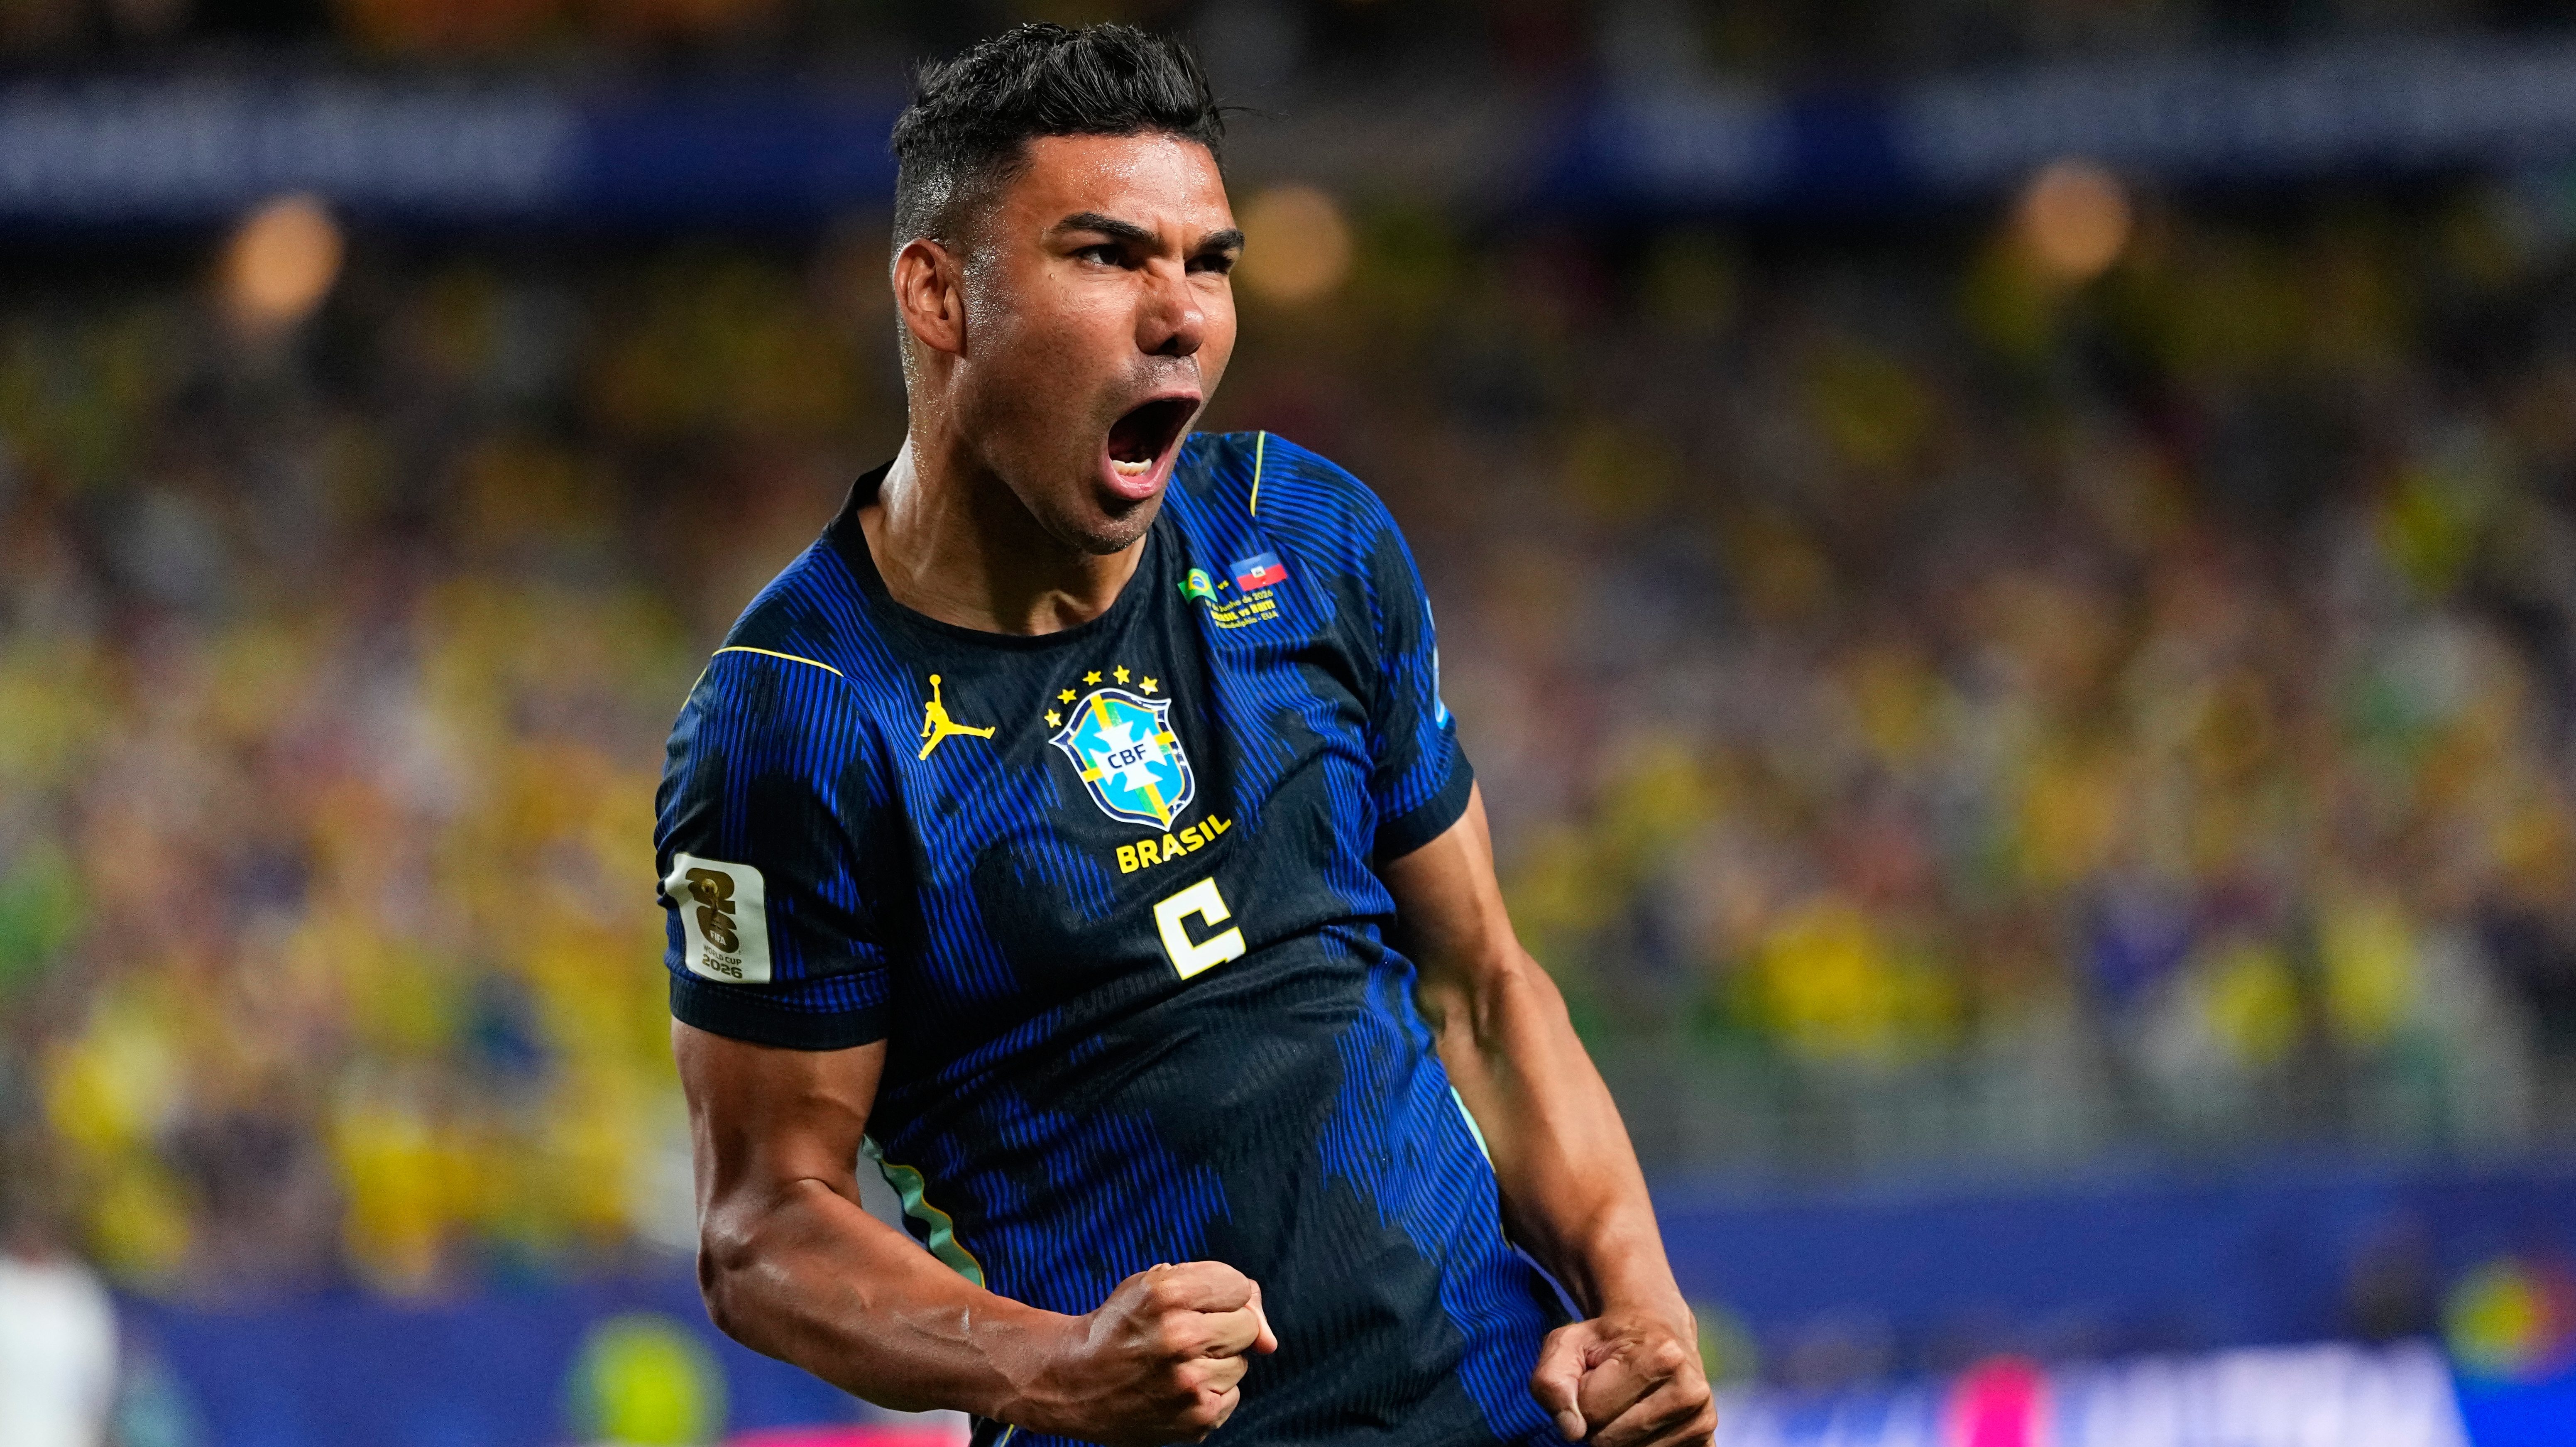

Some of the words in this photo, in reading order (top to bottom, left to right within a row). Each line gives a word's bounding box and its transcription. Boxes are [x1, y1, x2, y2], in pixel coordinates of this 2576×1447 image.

[1242, 595, 1253, 604] de
[1252, 590, 1274, 601] 2026
[1238, 608, 1251, 617] vs
[1260, 610, 1279, 620] EUA
[1108, 744, 1147, 769] CBF
[1116, 814, 1232, 874] BRASIL
[709, 930, 727, 946] FIFA
[703, 944, 724, 961] WORLD
[725, 957, 742, 965] CUP
[702, 954, 743, 979] 2026
